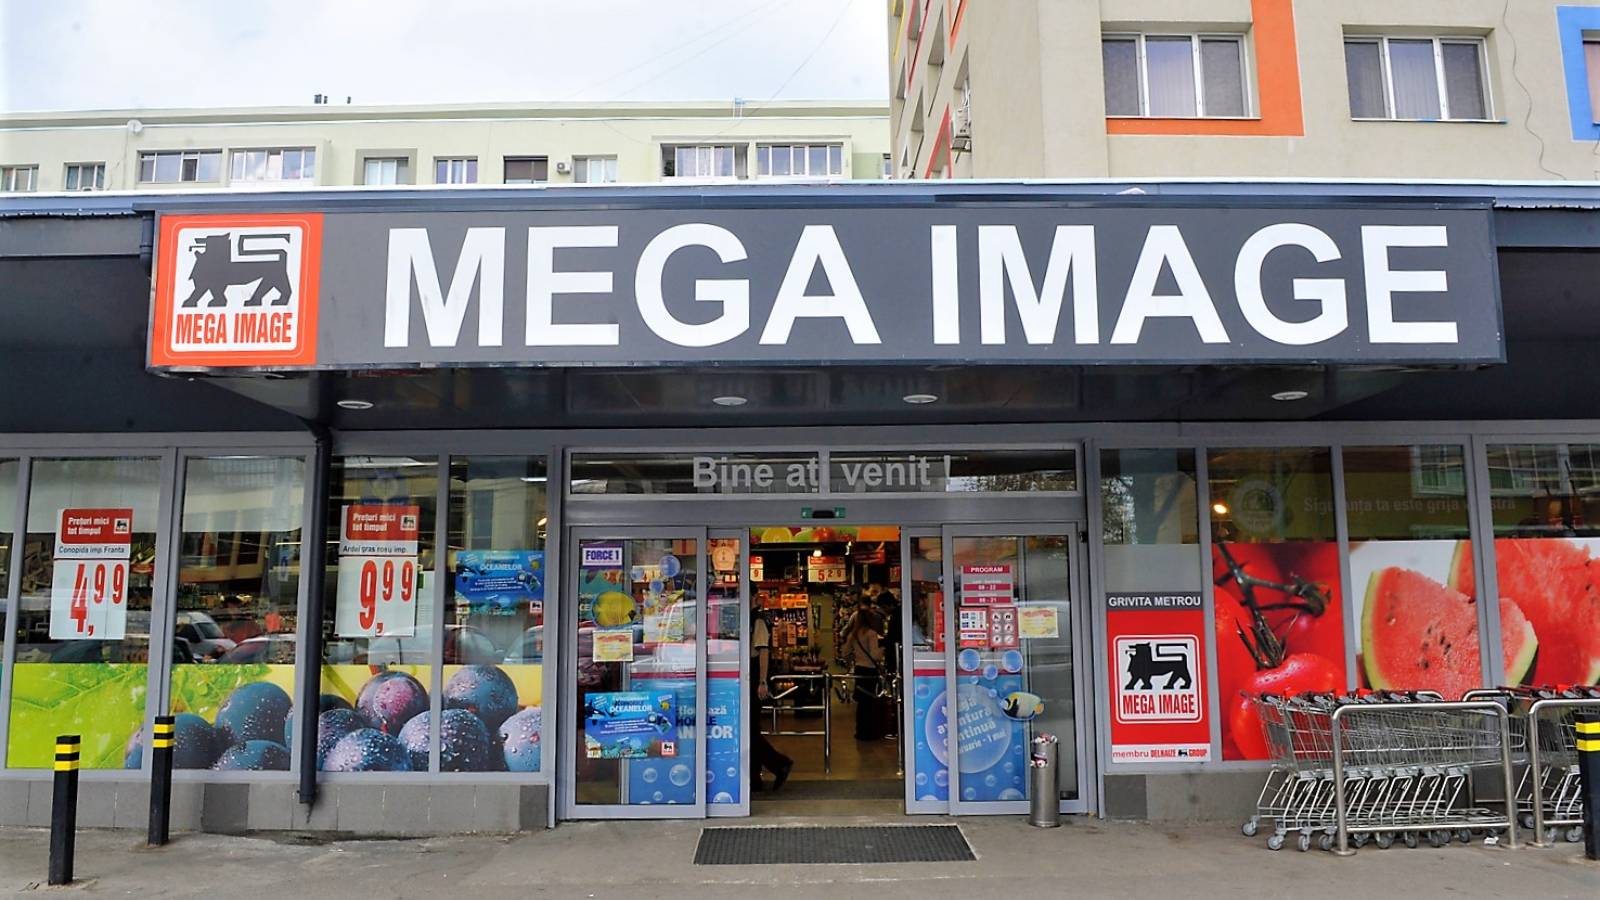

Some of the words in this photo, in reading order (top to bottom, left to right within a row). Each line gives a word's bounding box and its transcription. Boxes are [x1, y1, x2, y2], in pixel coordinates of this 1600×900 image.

[383, 223, 881, 348] MEGA
[930, 222, 1459, 346] IMAGE
[175, 313, 227, 344] MEGA
[233, 312, 293, 343] IMAGE
[693, 456, 774, 487] Bine
[840, 455, 931, 486] venit
[586, 550, 613, 560] FORCE
[1108, 596, 1152, 607] GRIVITA
[1154, 596, 1201, 607] METROU
[1122, 694, 1156, 715] MEGA
[1159, 694, 1195, 714] IMAGE
[1112, 749, 1149, 758] membru
[1188, 748, 1208, 758] GROUP
